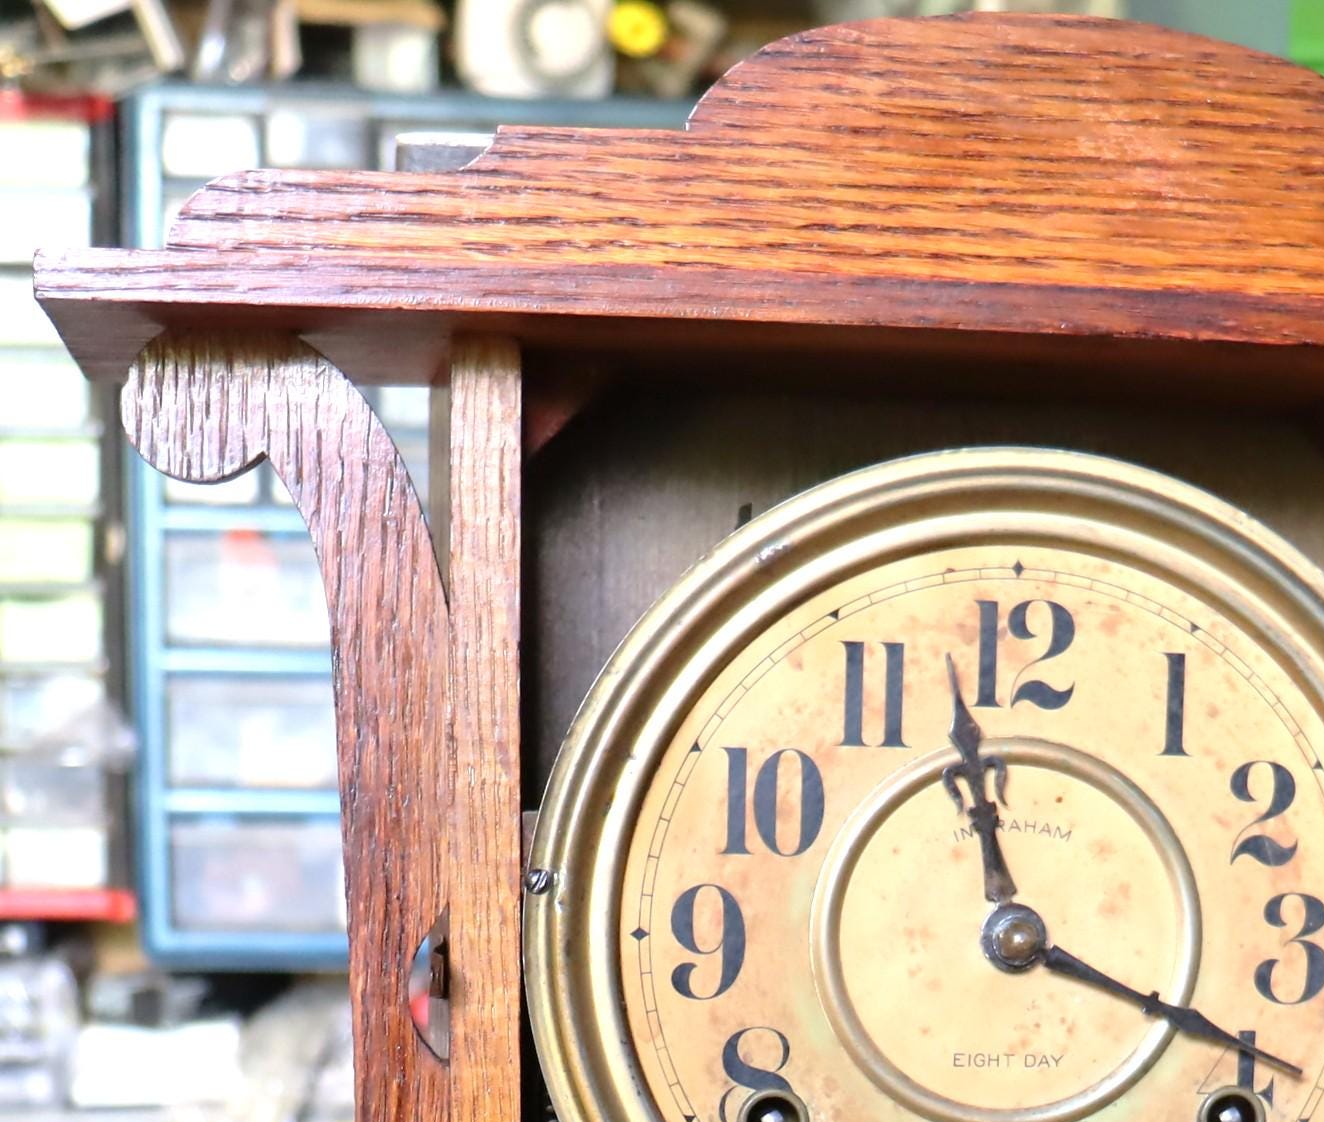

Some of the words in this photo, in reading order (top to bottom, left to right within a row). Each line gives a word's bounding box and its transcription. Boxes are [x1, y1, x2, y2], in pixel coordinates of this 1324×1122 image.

[834, 641, 911, 748] 11
[969, 599, 1075, 710] 12
[1158, 652, 1191, 757] 1
[716, 747, 825, 857] 10
[953, 819, 1072, 842] INRAHAM
[1230, 760, 1298, 867] 2
[671, 884, 746, 1000] 9
[953, 1053, 1015, 1068] EIGHT
[1024, 1054, 1064, 1068] DAY
